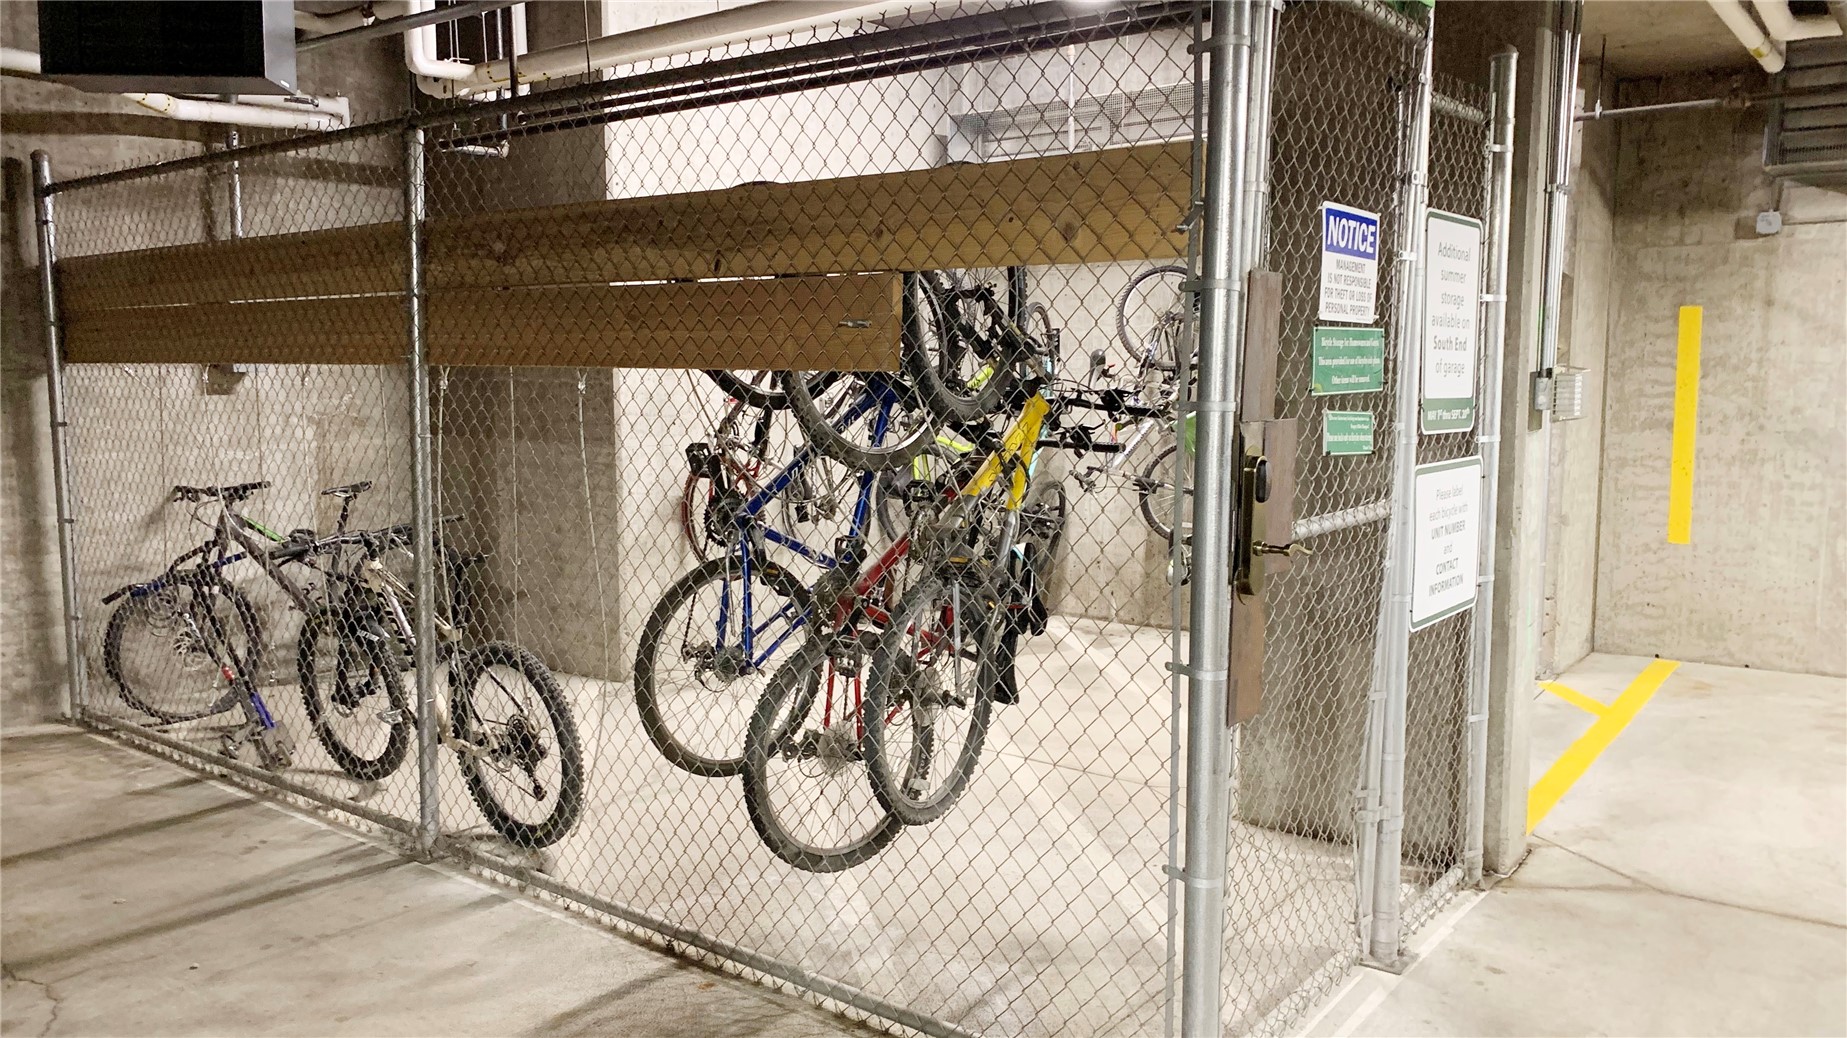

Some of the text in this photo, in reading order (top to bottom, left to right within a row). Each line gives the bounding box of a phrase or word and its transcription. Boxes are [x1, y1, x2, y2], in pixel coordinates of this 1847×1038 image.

[1327, 215, 1376, 254] NOTICE
[1437, 242, 1471, 262] Additional
[1336, 258, 1366, 274] MANAGEMENT
[1440, 269, 1466, 285] summer
[1441, 291, 1464, 310] storage
[1432, 313, 1470, 330] available on
[1433, 335, 1467, 352] South End
[1435, 358, 1465, 378] of garage
[1436, 484, 1464, 501] Please label
[1431, 519, 1466, 540] UNIT NUMBER
[1436, 557, 1458, 576] CONTACT
[1428, 573, 1464, 597] INFORMATION
